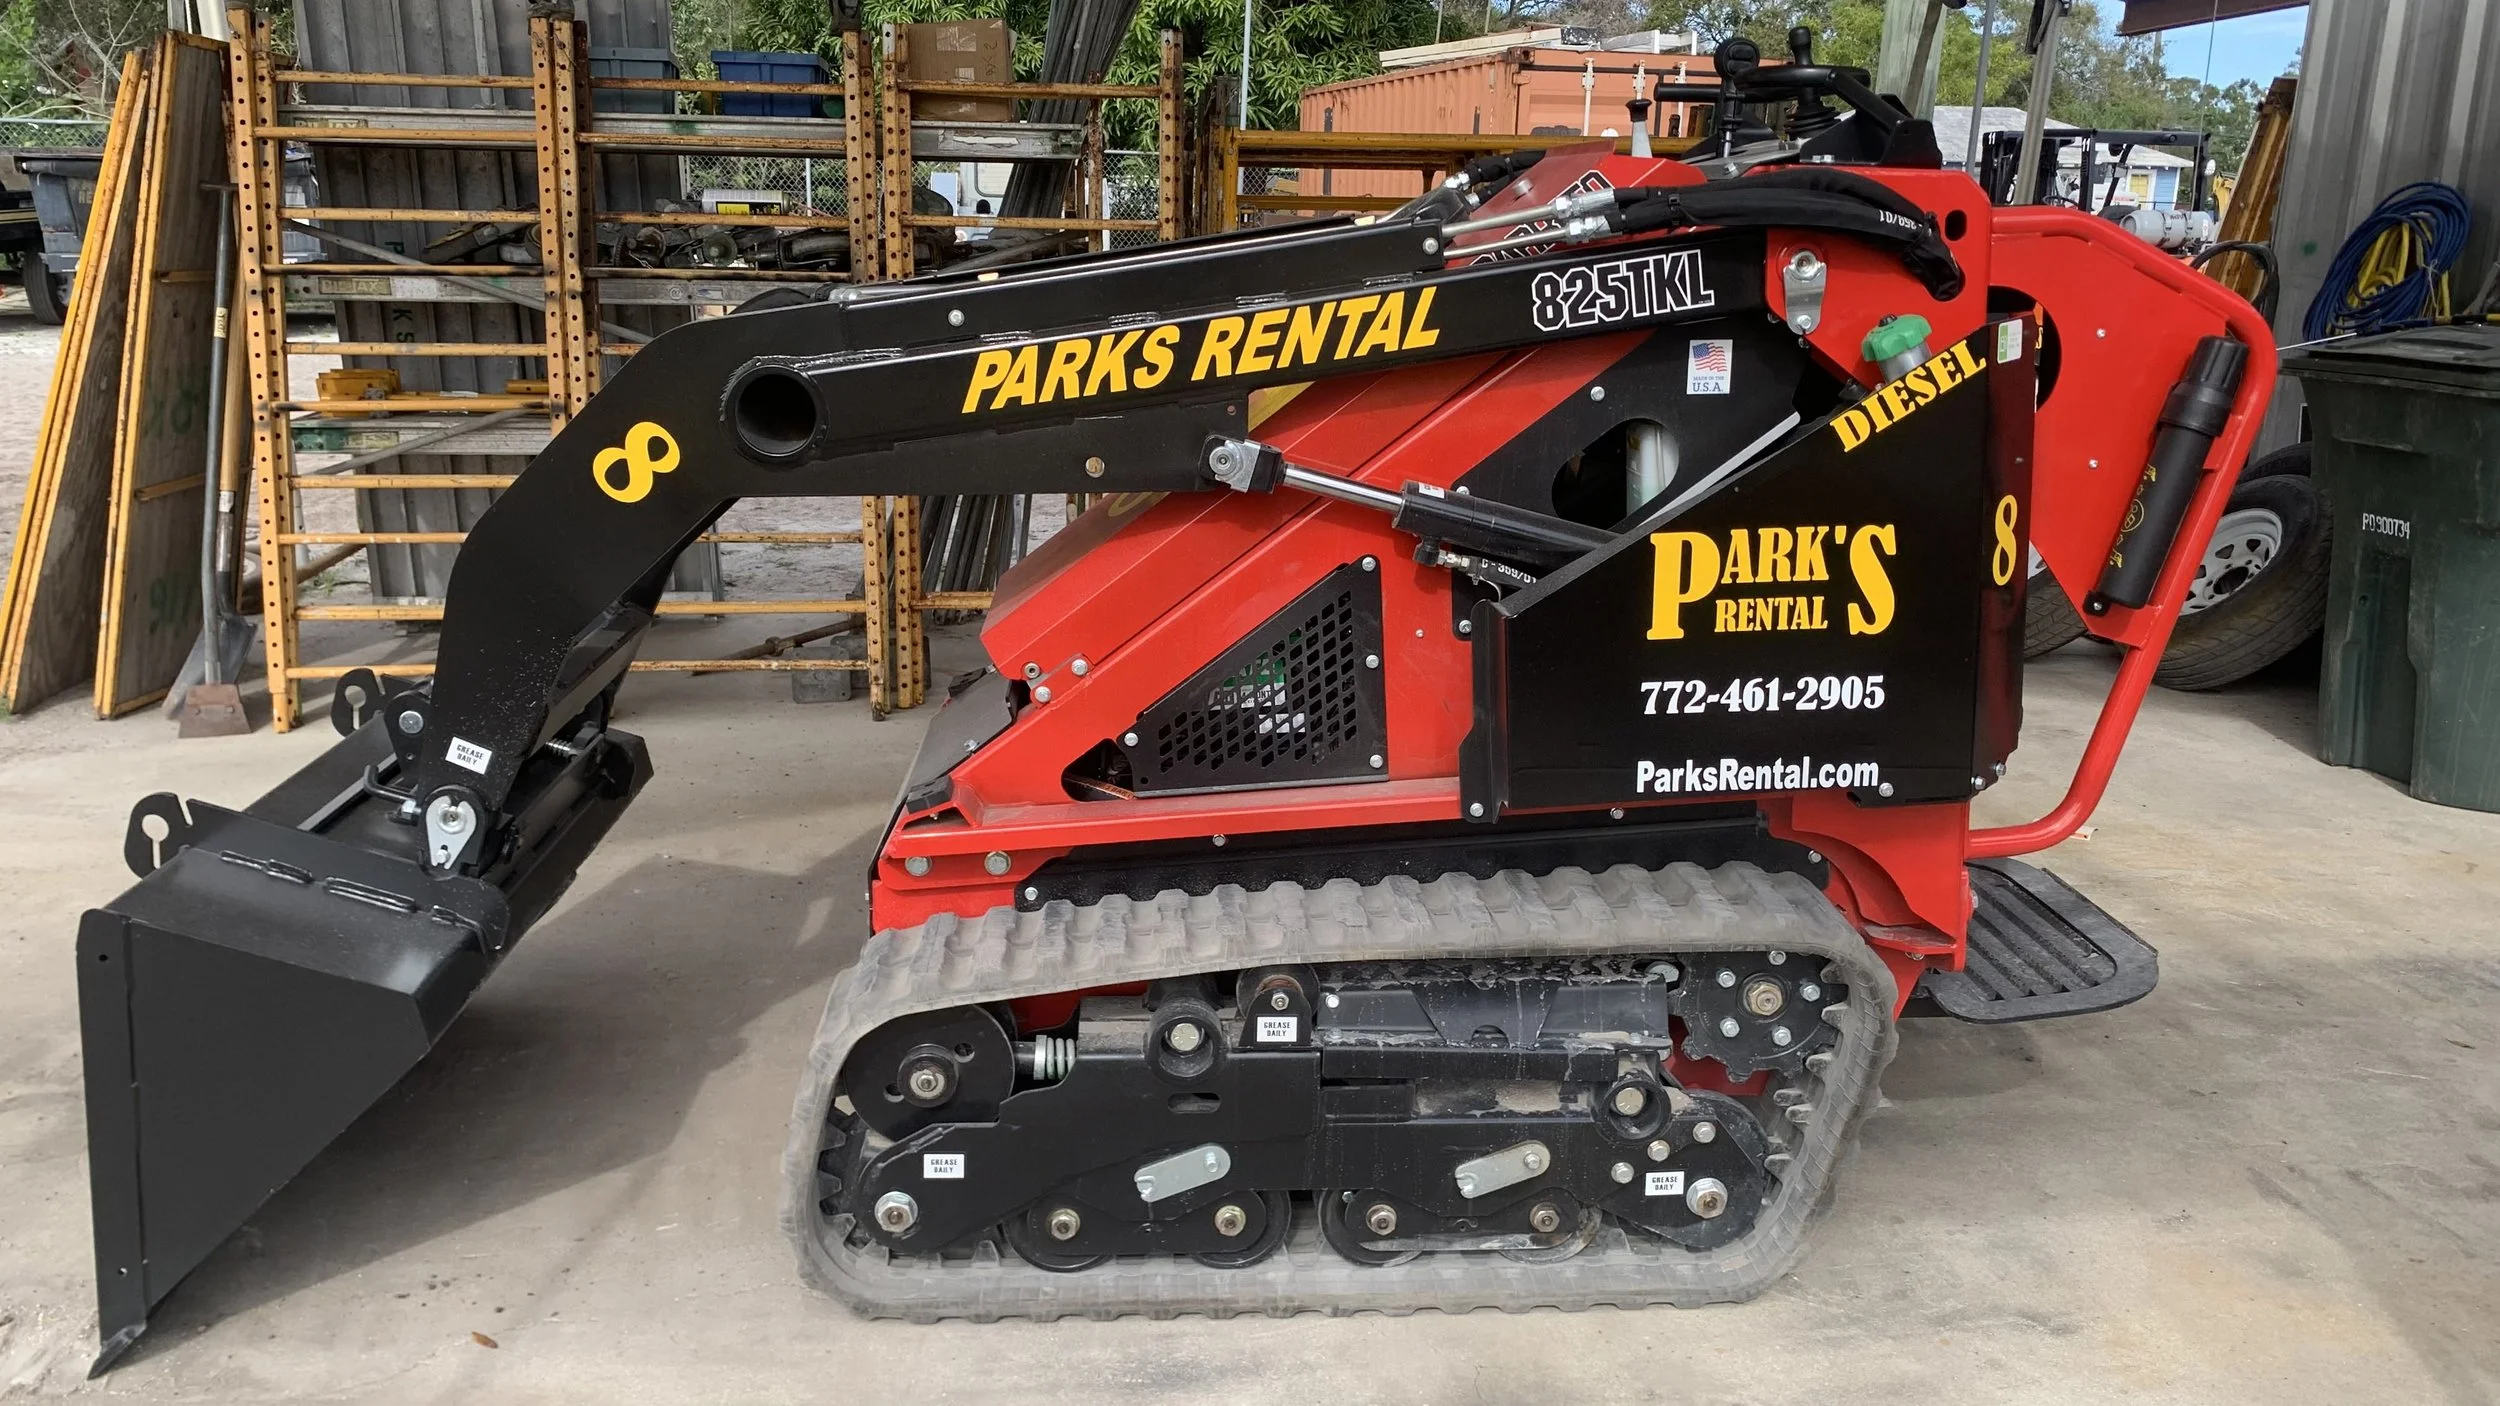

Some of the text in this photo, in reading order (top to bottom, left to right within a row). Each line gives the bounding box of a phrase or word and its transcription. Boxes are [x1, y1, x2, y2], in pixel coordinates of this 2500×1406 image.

[1988, 132, 1996, 145] 11
[2082, 138, 2091, 152] 11
[1531, 249, 1715, 332] 825TKL
[961, 286, 1440, 414] PARKS RENTAL
[1692, 382, 1724, 392] U.S.A.
[1829, 339, 1987, 453] DIESEL
[592, 421, 680, 503] 8
[1992, 494, 2018, 586] 8
[1646, 524, 1897, 641] PARK'S
[1714, 596, 1829, 633] RENTAL
[1640, 675, 1886, 715] 772-461-2905
[457, 744, 484, 760] GREASE
[457, 753, 478, 765] DAILY
[1636, 755, 1879, 793] ParksRental.com
[1263, 1021, 1291, 1029] GREASE
[1266, 1029, 1287, 1037] DAILY
[930, 1158, 958, 1166] GREASE
[1652, 1175, 1678, 1183] GREASE
[1654, 1183, 1674, 1191] DAILY
